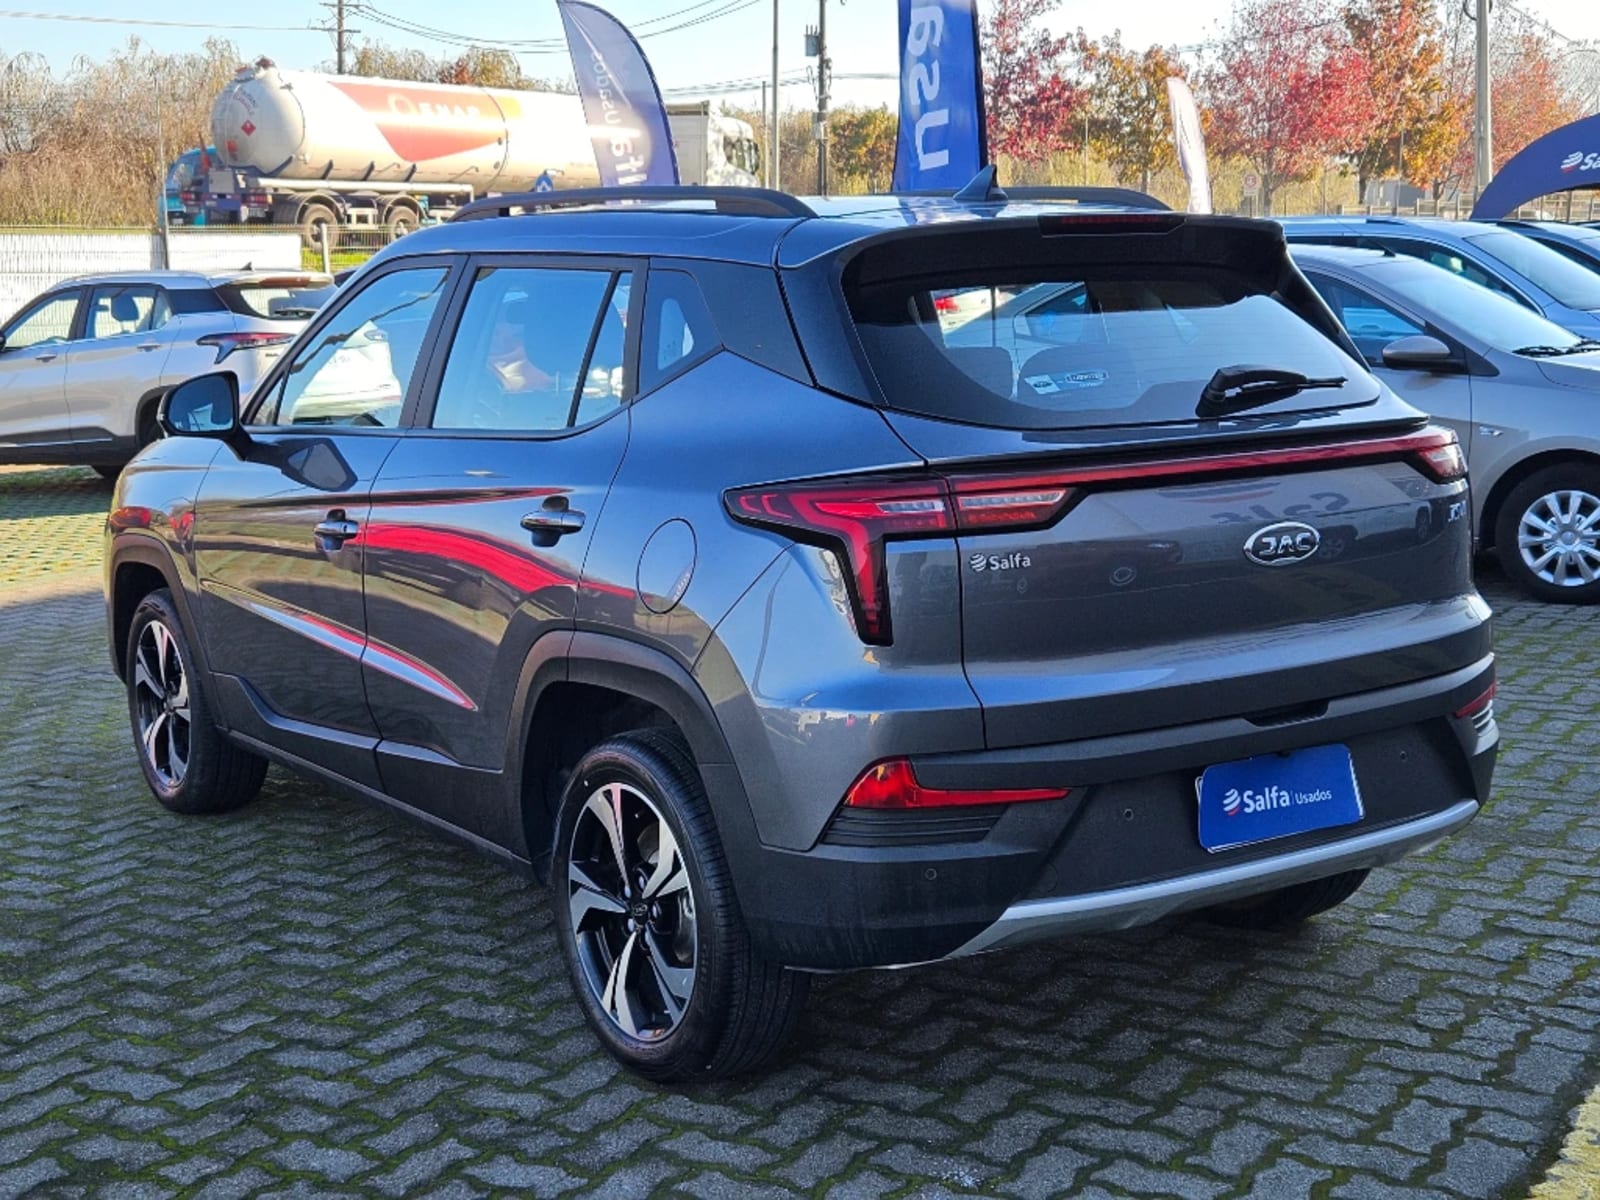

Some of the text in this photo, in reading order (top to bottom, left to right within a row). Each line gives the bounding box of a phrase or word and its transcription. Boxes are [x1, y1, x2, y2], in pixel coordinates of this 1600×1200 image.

[1259, 532, 1312, 556] JAC
[988, 552, 1031, 571] Salfa
[1242, 785, 1332, 813] Salfa Usados
